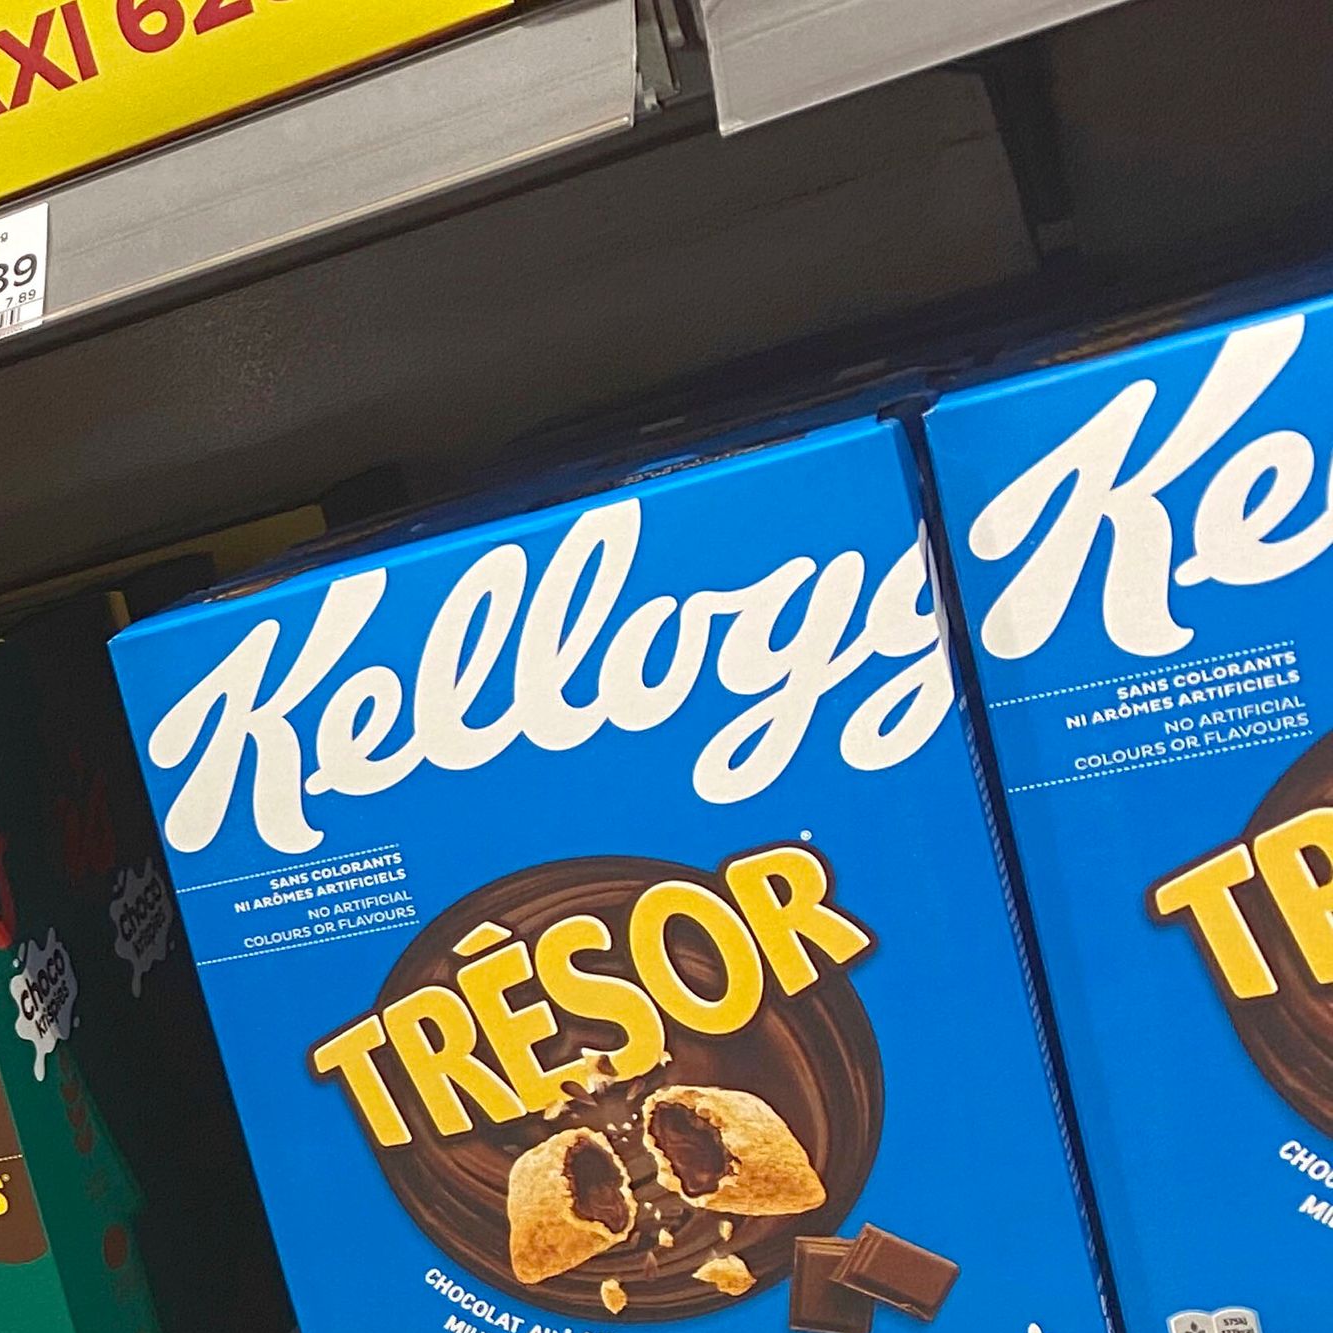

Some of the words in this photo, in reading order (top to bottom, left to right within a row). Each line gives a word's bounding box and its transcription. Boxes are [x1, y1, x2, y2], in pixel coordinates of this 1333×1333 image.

[1065, 714, 1086, 729] NI
[1091, 692, 1173, 726] ARÔMES
[1178, 669, 1300, 707] ARTIFICIELS
[1117, 678, 1169, 702] SANS
[1173, 651, 1296, 691] COLORANTS
[1164, 718, 1193, 735] NO
[1199, 696, 1305, 729] ARTIFICIAL
[1075, 742, 1166, 771] COLOURS
[1170, 734, 1196, 751] OR
[1203, 713, 1309, 747] FLAVOURS
[233, 900, 251, 913] NI
[252, 883, 314, 908] ARÔMES
[314, 867, 407, 899] ARTIFICIELS
[269, 869, 308, 890] SANS
[310, 851, 403, 885] COLORANTS
[307, 904, 329, 920] NO
[331, 889, 412, 915] ARTIFICIAL
[314, 846, 871, 1148] TRÉSOR
[425, 1268, 524, 1333] CHOCOLAT
